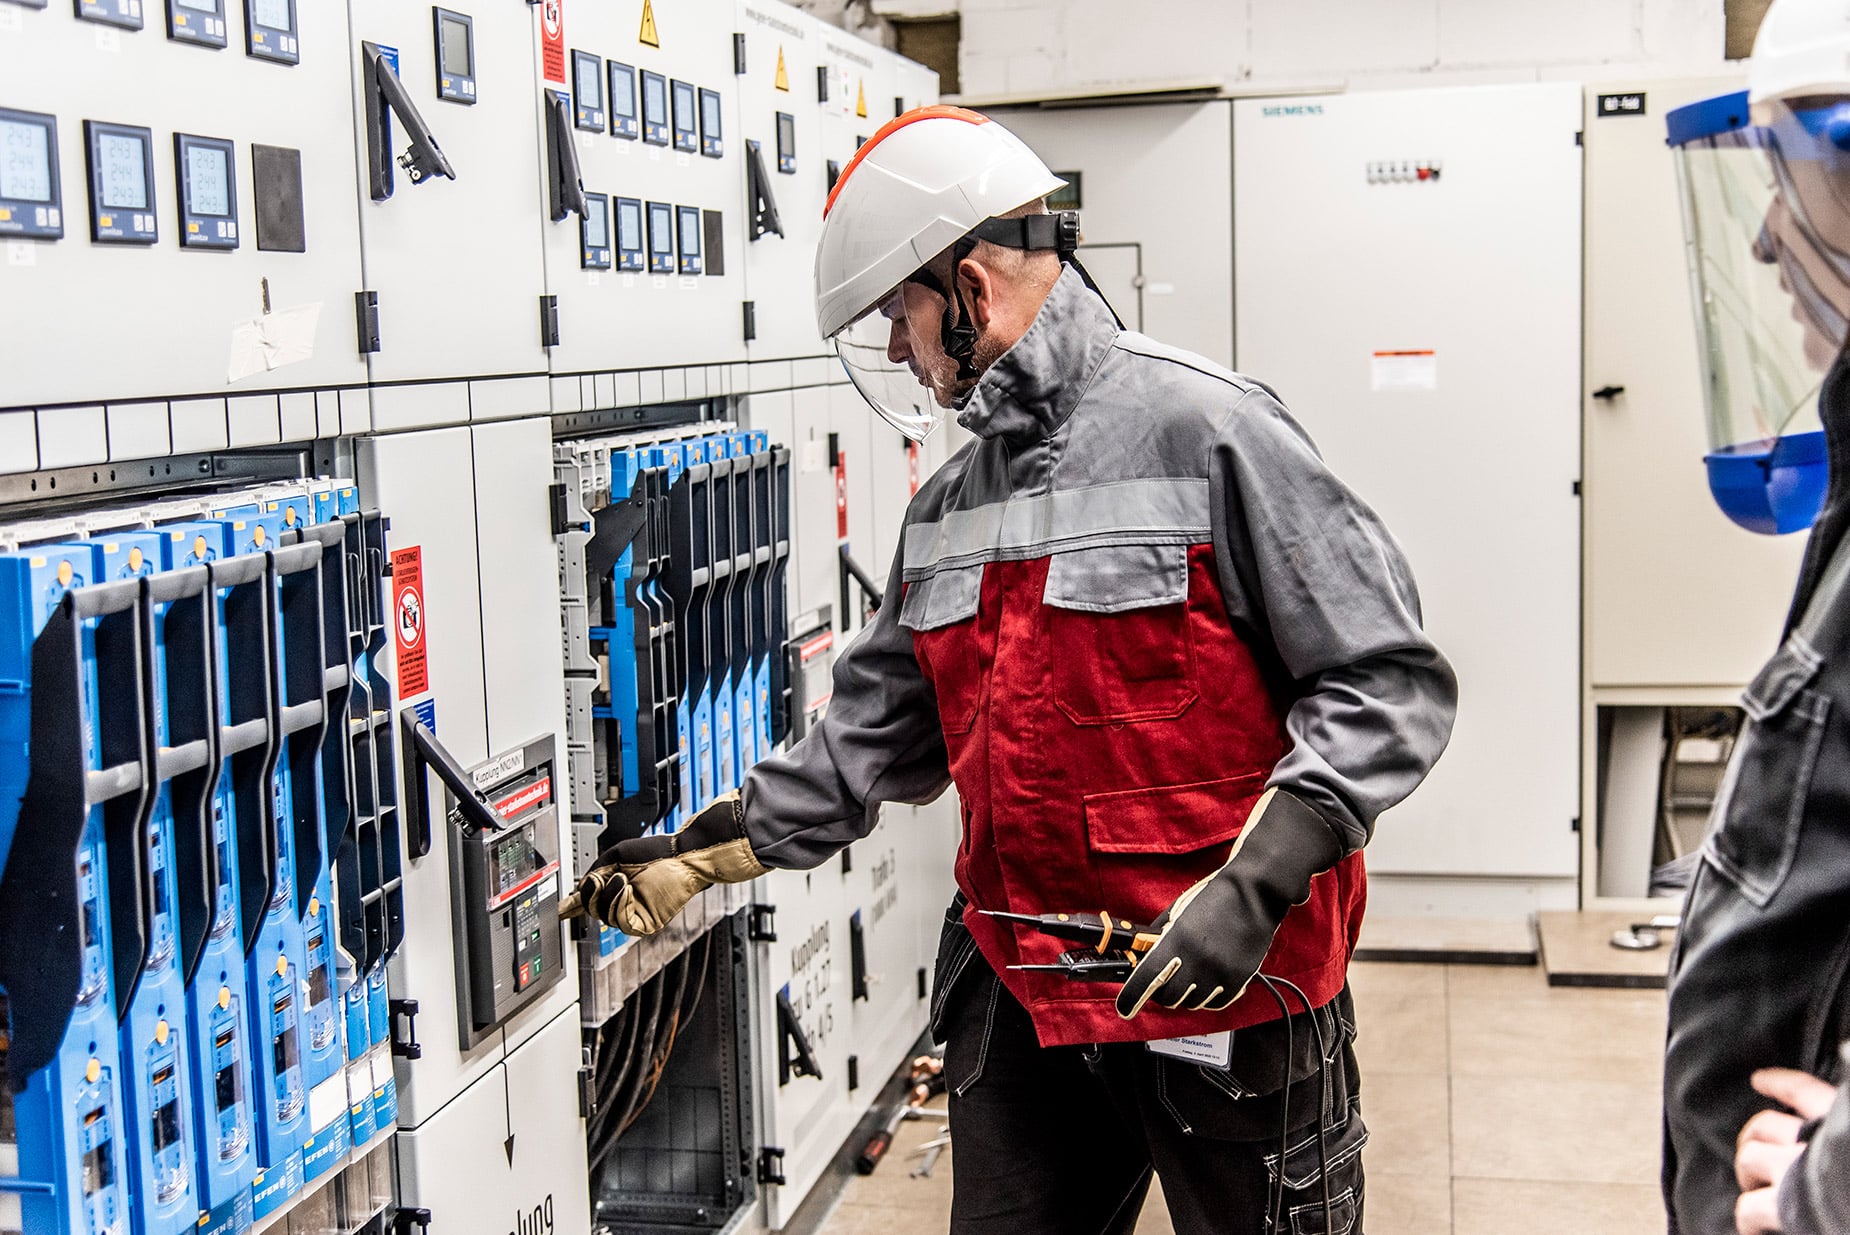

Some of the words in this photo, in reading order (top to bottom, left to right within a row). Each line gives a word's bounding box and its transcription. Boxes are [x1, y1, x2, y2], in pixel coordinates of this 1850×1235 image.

[1262, 106, 1323, 118] SIEMENS
[196, 151, 216, 169] 243
[199, 195, 217, 212] 243
[791, 919, 830, 978] Kupplung
[1181, 1038, 1213, 1049] Starkstrom
[304, 1146, 329, 1166] EFEN
[254, 1183, 279, 1204] EFEN
